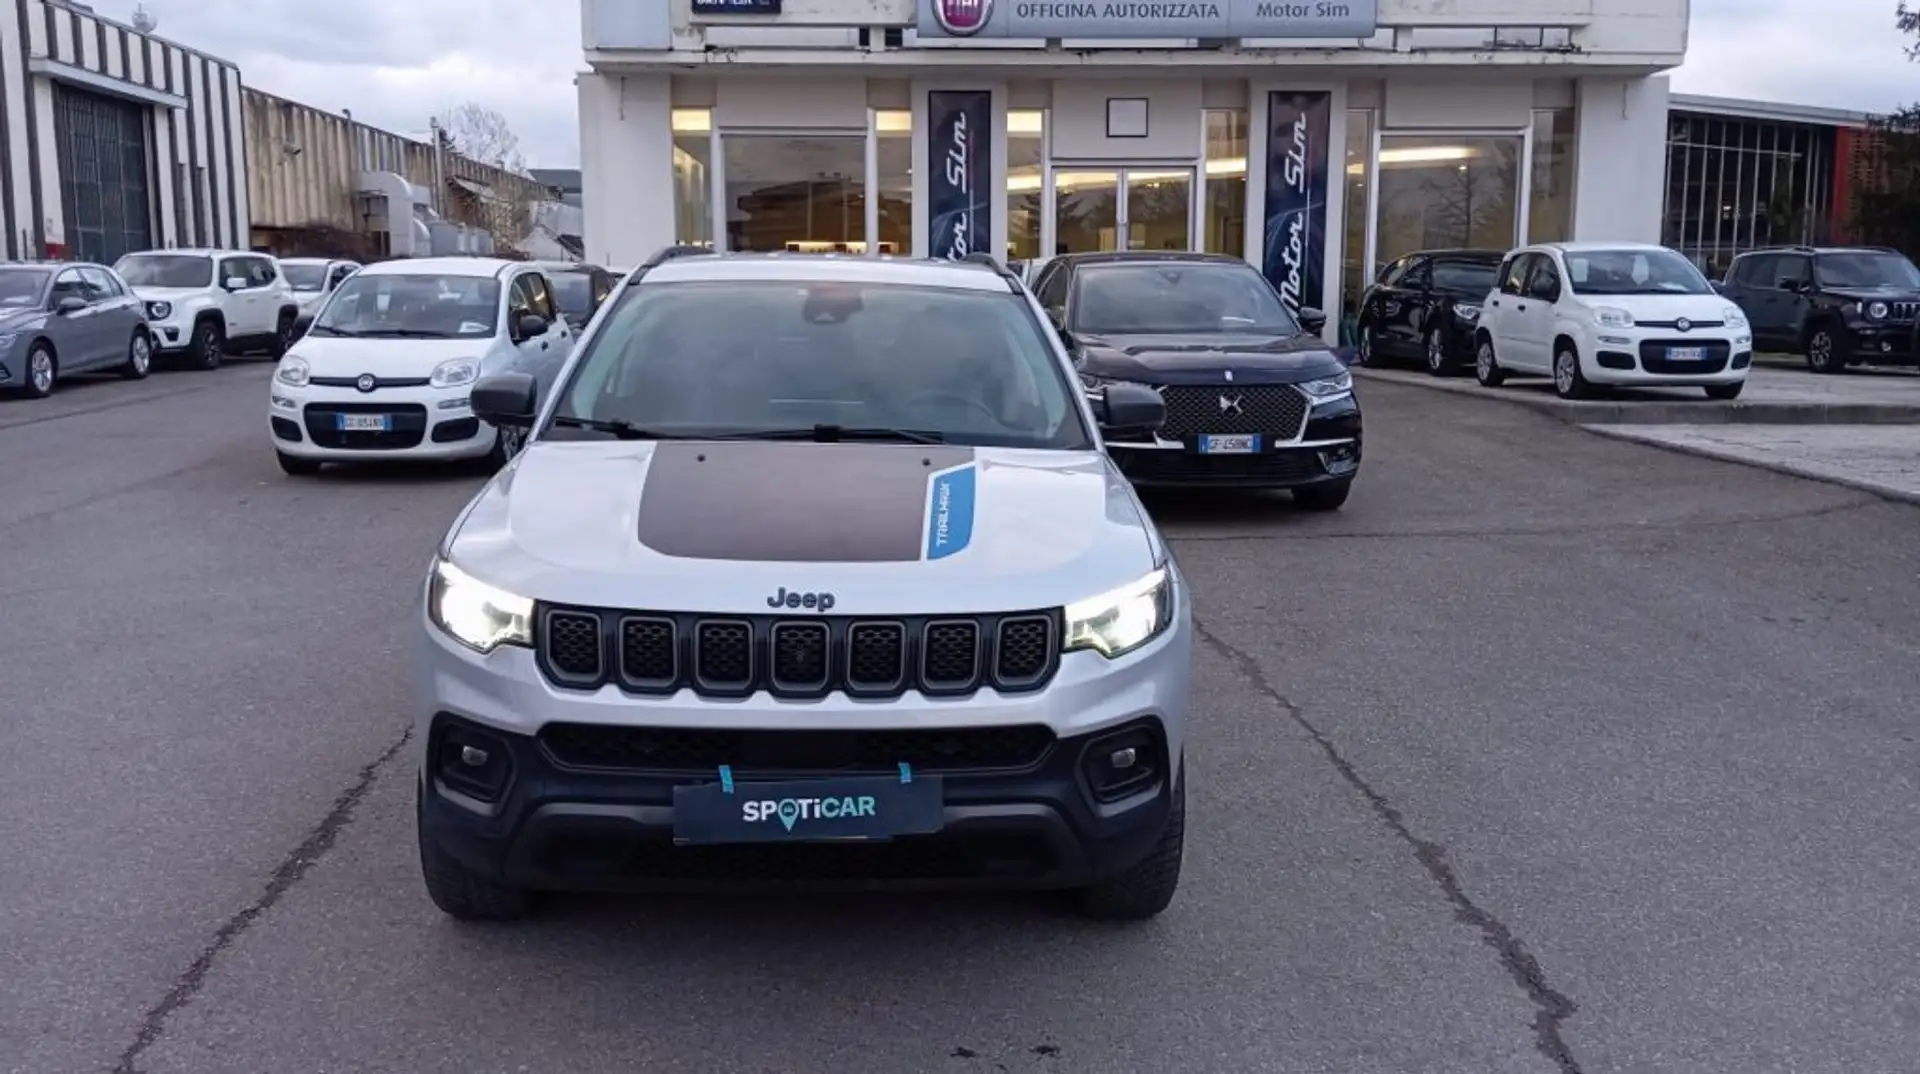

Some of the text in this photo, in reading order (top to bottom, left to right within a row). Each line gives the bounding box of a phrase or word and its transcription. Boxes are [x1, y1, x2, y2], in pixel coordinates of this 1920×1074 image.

[1016, 2, 1220, 18] OFFICINA AUTORIZZATA
[1256, 1, 1350, 18] Motor Sim
[946, 111, 968, 194] Sim
[1284, 111, 1307, 194] Sim
[936, 479, 951, 548] TRAILHAWK
[766, 586, 836, 612] Jeep
